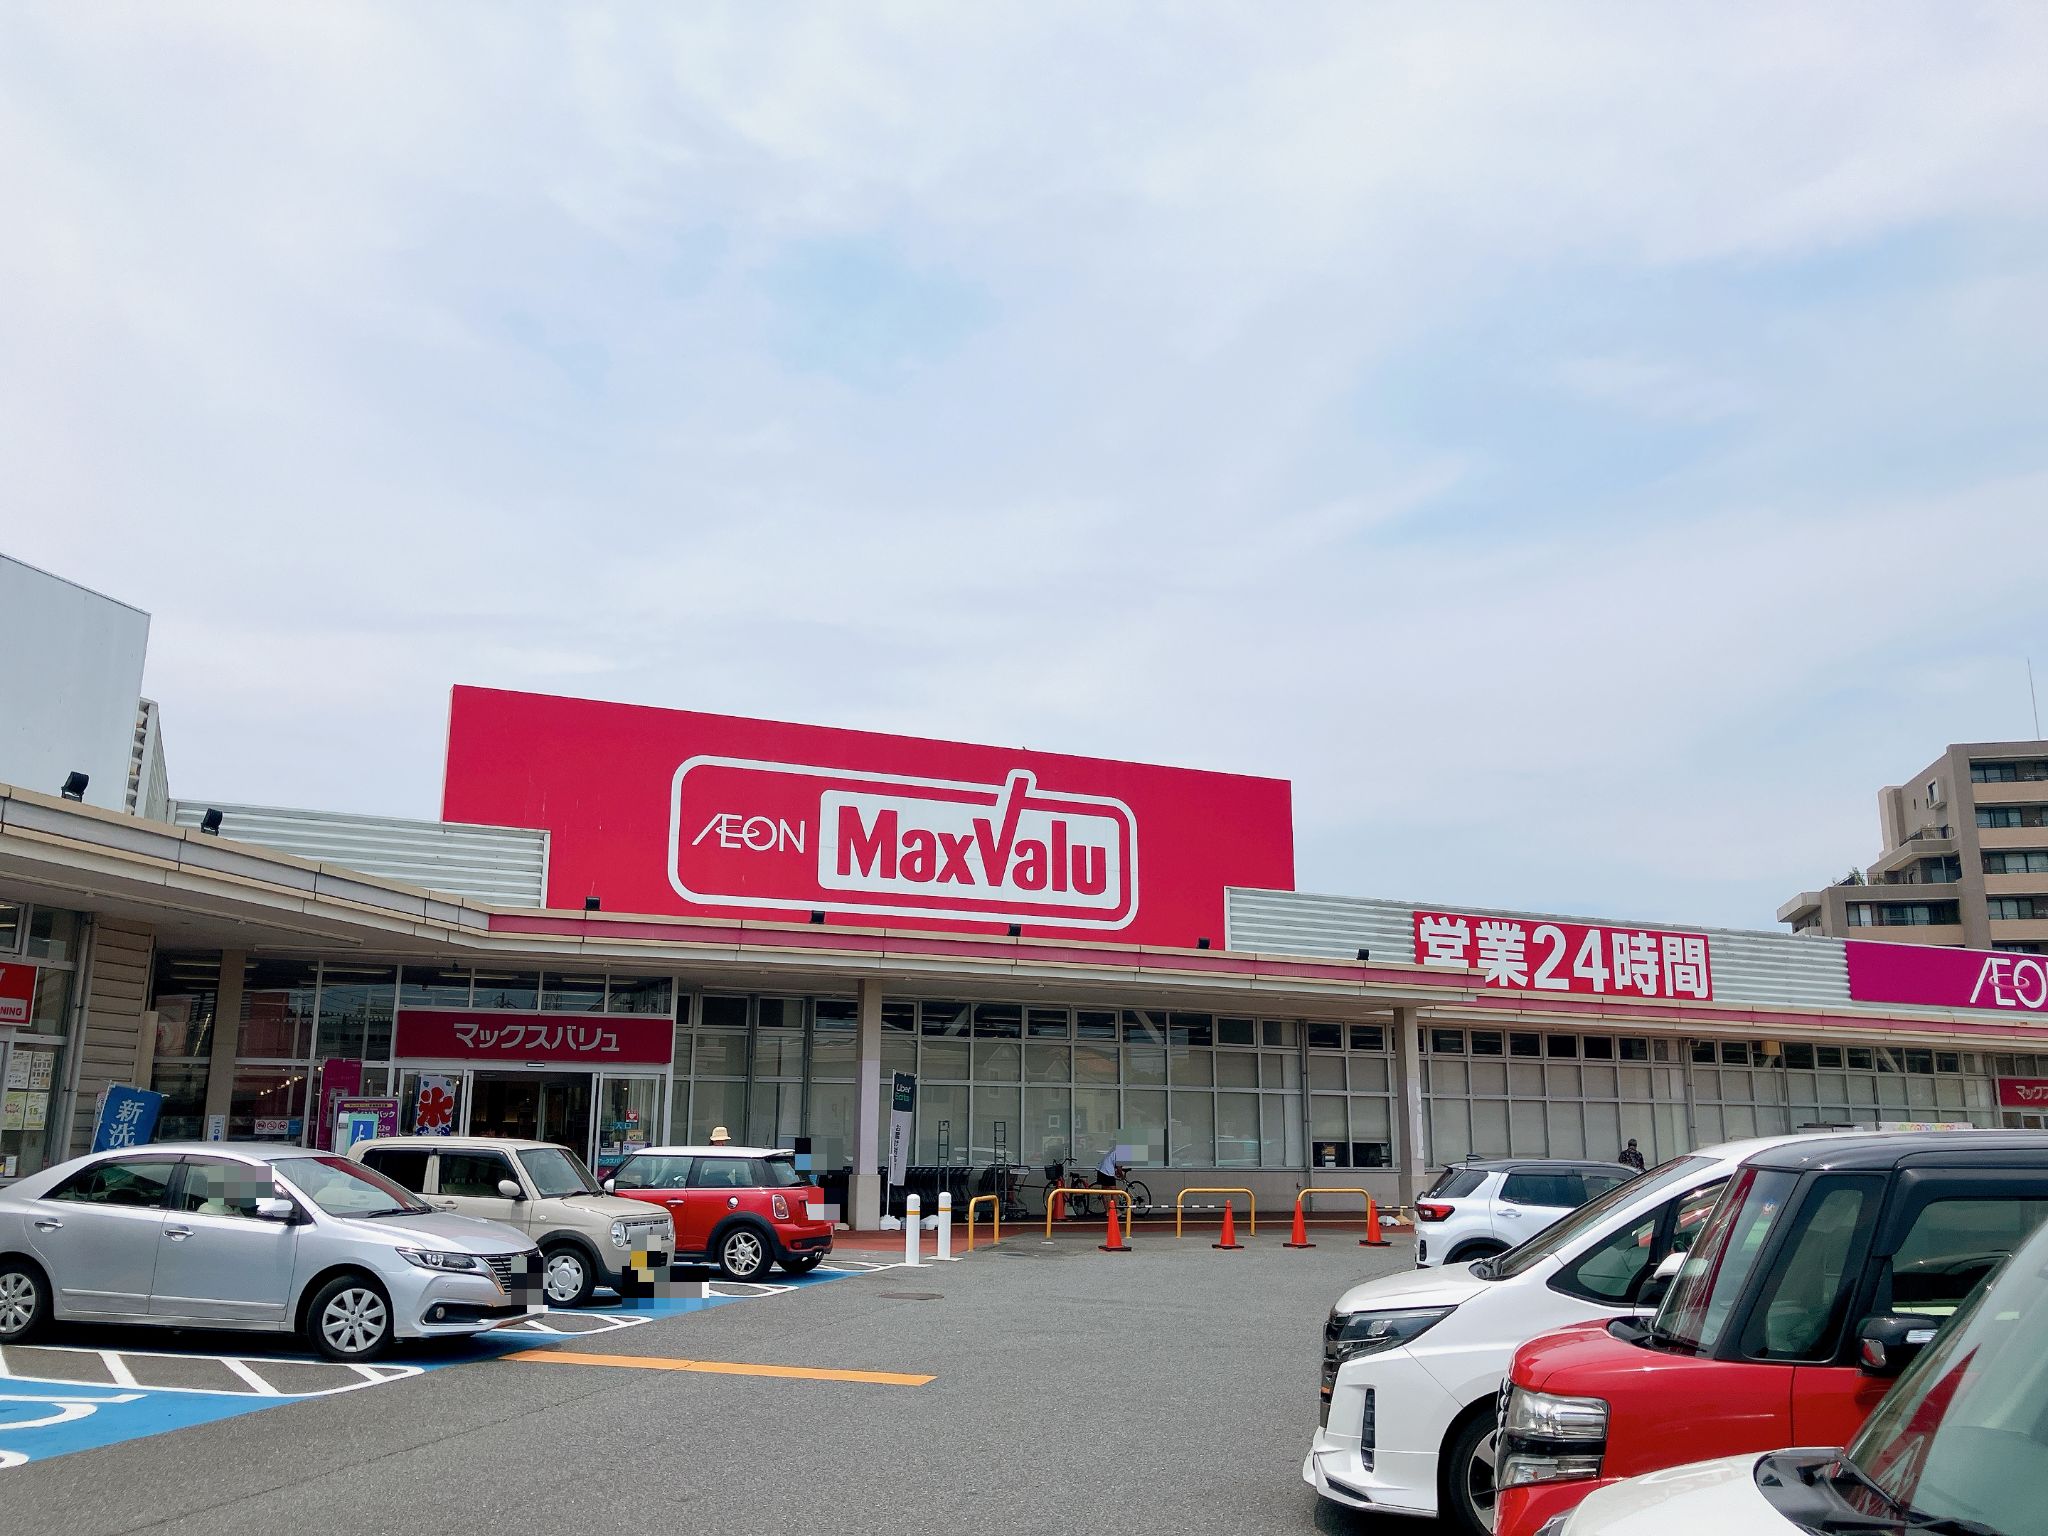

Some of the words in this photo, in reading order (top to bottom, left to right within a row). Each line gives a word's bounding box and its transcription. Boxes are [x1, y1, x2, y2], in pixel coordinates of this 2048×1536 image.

[837, 777, 1107, 896] MaxValu
[1419, 916, 1709, 999] 営業24時間
[1969, 957, 2048, 1009] AEO
[453, 1023, 620, 1052] マックスバリュ
[417, 1086, 454, 1127] 氷
[896, 1083, 911, 1094] Uber
[107, 1099, 145, 1149] 新洗
